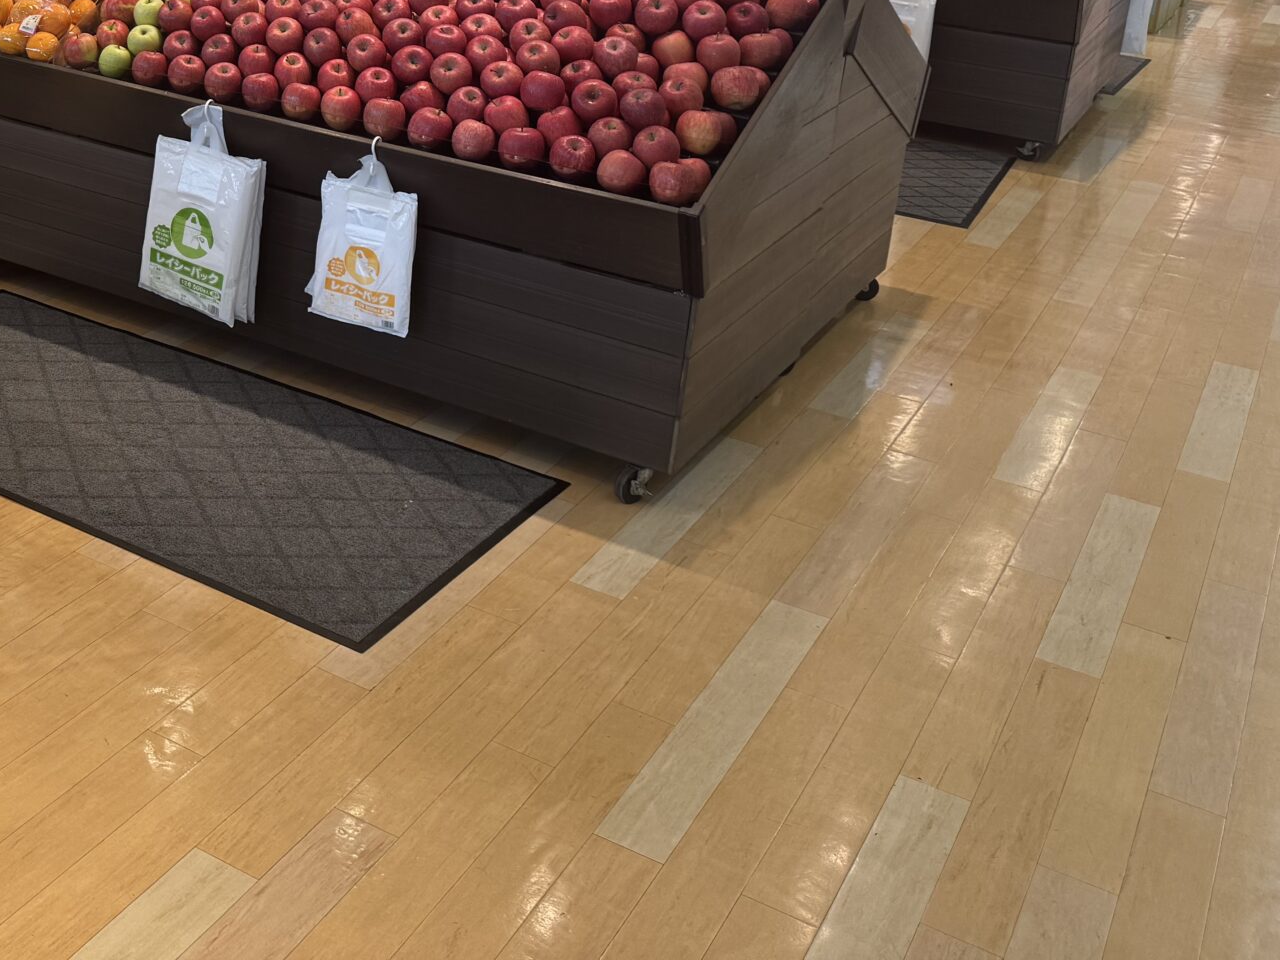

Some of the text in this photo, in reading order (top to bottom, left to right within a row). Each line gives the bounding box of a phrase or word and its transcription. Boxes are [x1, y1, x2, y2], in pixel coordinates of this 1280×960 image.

[156, 251, 219, 285] レイシーパック
[330, 279, 389, 305] レイシーパック
